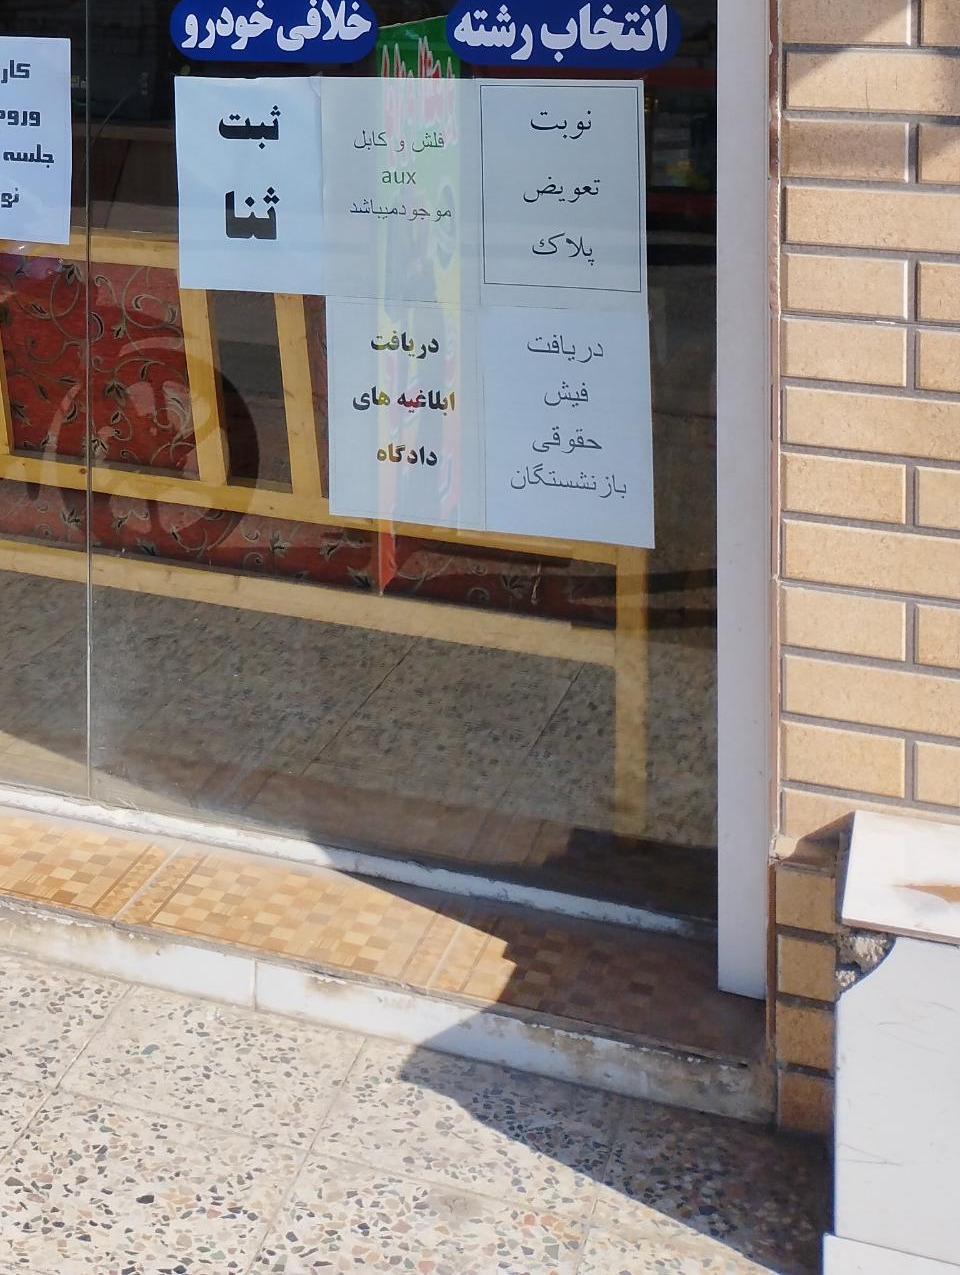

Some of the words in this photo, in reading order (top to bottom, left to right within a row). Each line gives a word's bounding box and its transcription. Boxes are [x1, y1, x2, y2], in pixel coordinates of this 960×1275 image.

[181, 0, 273, 51] خودرو
[453, 3, 534, 60] رشته
[540, 2, 669, 61] انتخاب
[218, 105, 281, 150] ثبت
[529, 107, 592, 136] نوبت
[353, 130, 387, 152] کابل
[394, 138, 406, 153] و
[3, 148, 55, 170] جلسه
[381, 168, 417, 186] aux
[523, 177, 600, 204] تعویض
[225, 184, 281, 240] ثنا
[531, 231, 595, 267] پلاک
[370, 332, 439, 360] دریافت
[526, 335, 604, 360] دریافت
[352, 388, 391, 412] های
[397, 390, 456, 413] ابلاغیه
[543, 383, 590, 408] فیش
[531, 427, 602, 455] حقوقی
[376, 442, 438, 468] دادگاه
[510, 465, 628, 498] بازنشستگان
